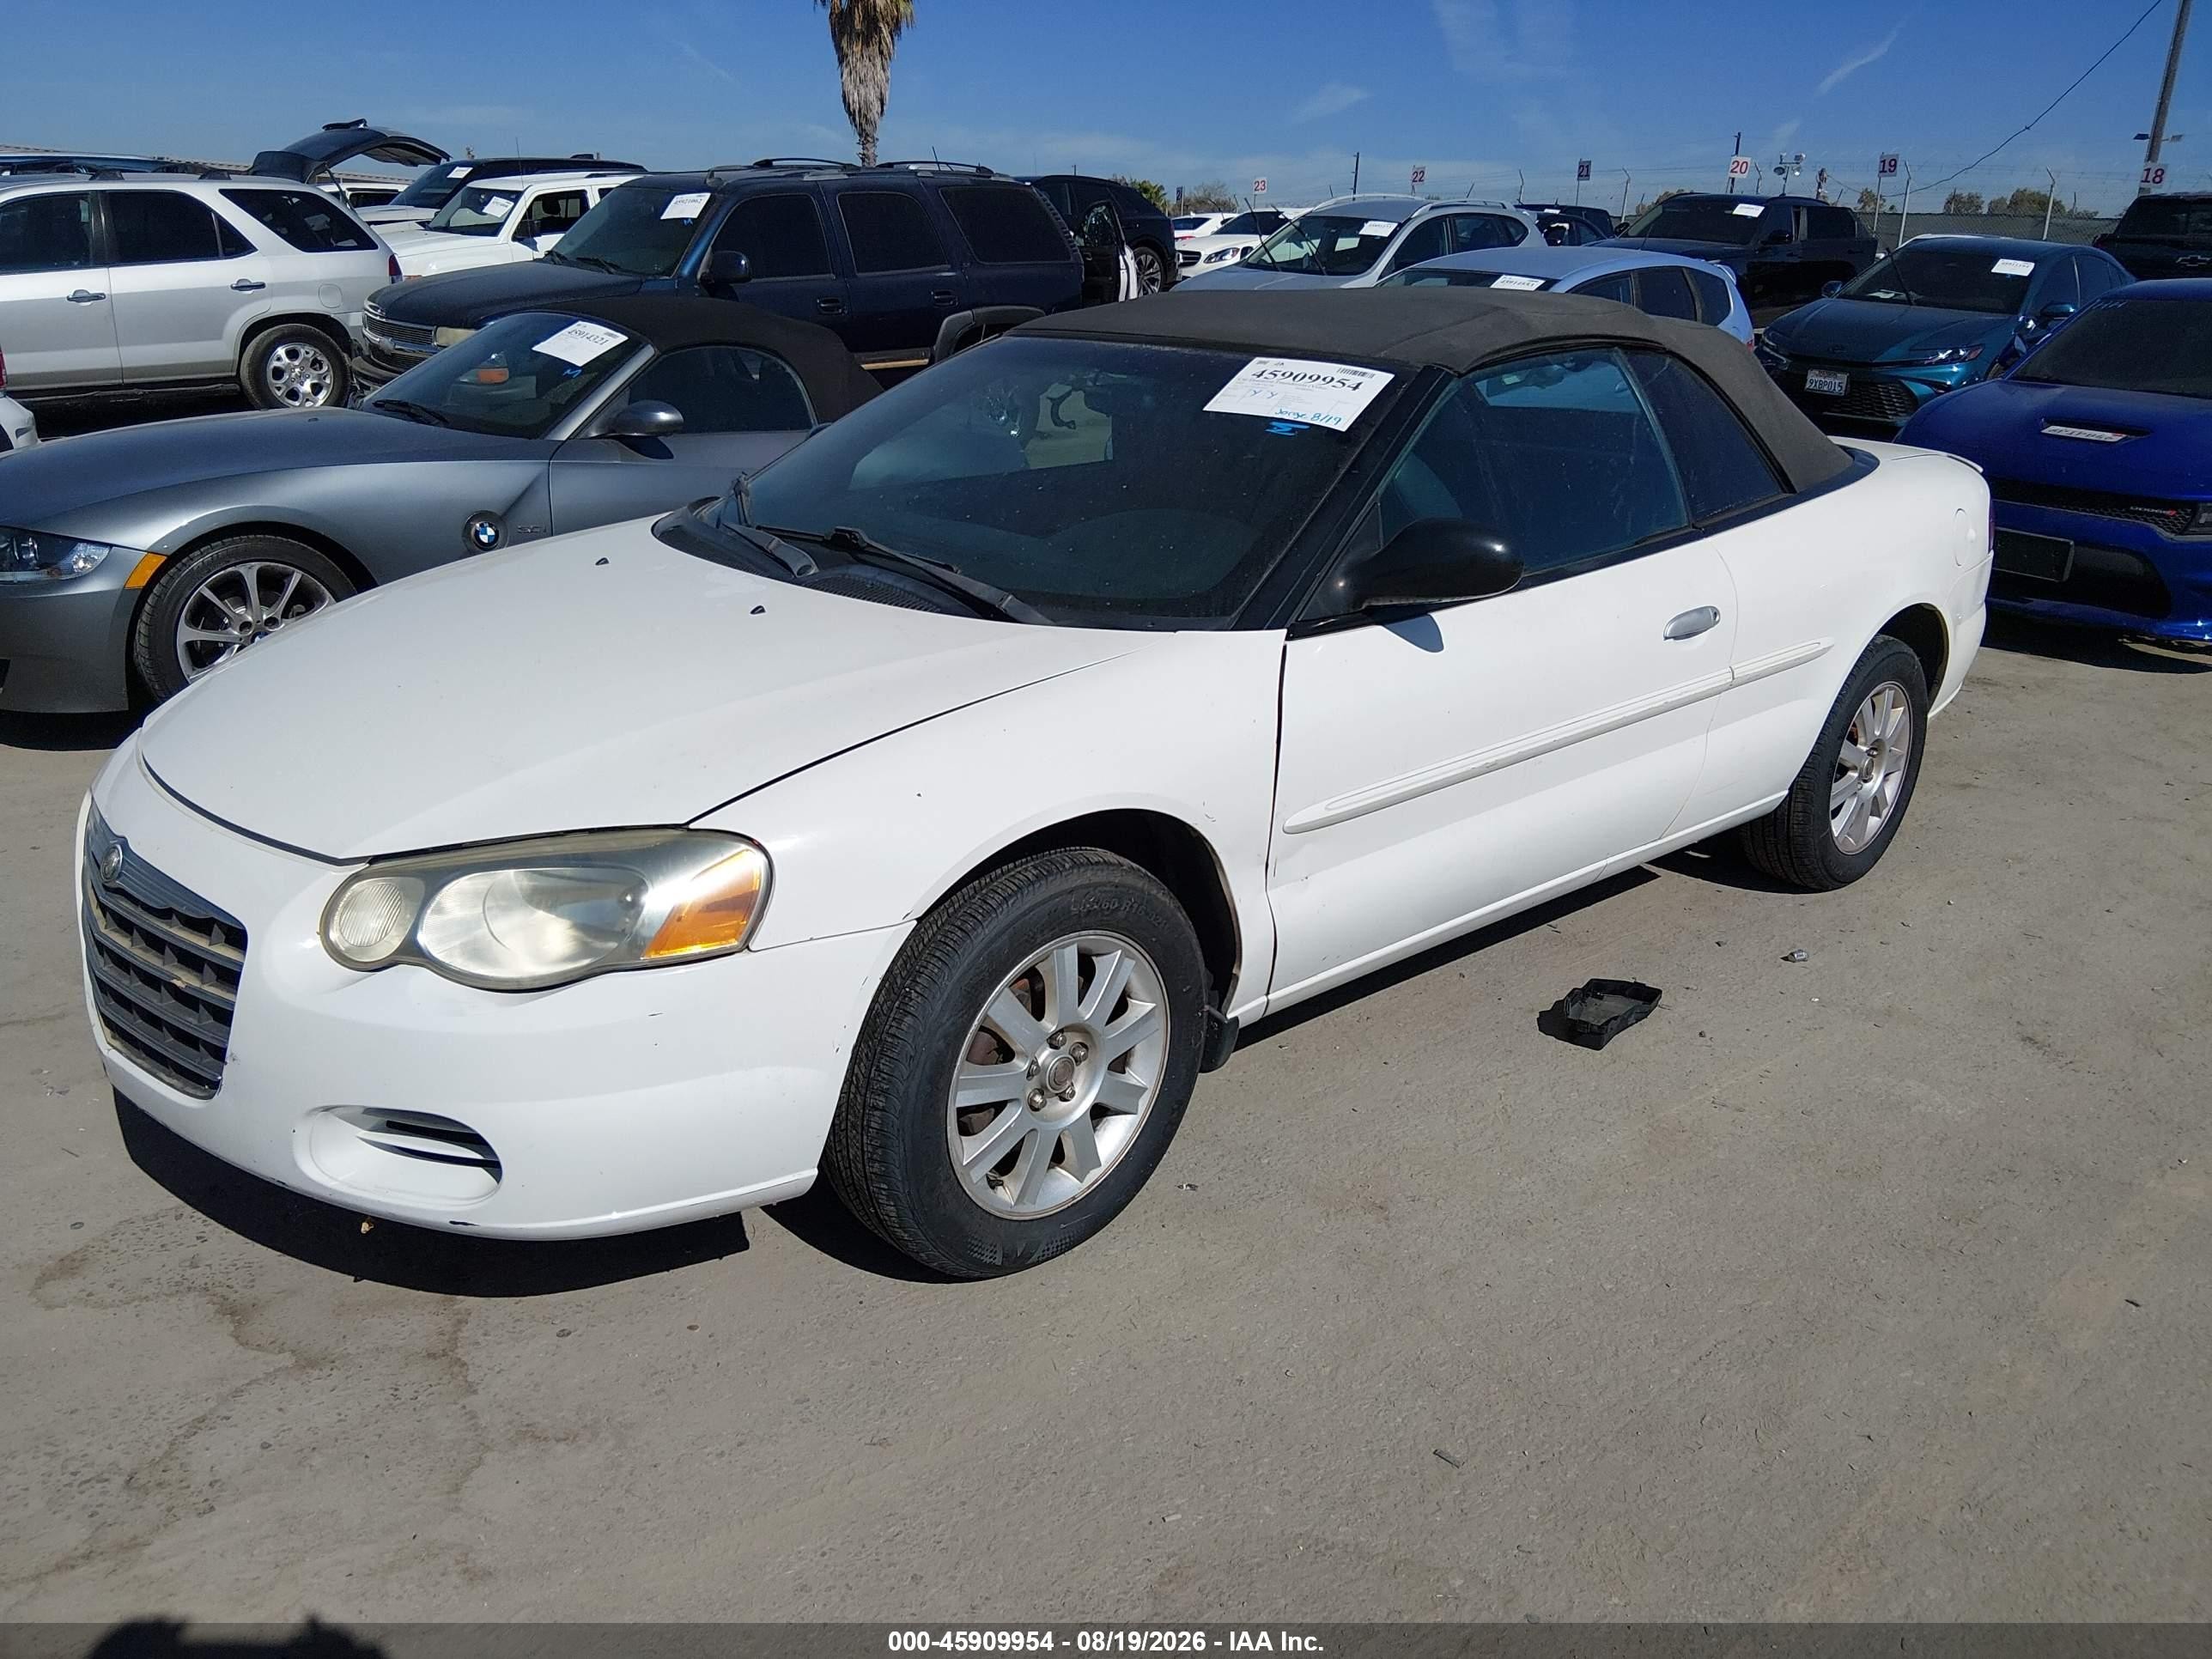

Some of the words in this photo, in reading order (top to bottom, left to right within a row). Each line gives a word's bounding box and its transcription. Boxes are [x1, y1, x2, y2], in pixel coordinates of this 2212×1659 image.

[1577, 164, 1590, 178] 21
[1730, 160, 1748, 174] 20
[1879, 158, 1898, 173] 19
[1412, 170, 1425, 183] 22
[2141, 167, 2165, 185] 18
[1254, 179, 1267, 191] 23
[1251, 368, 1364, 392] 45909954
